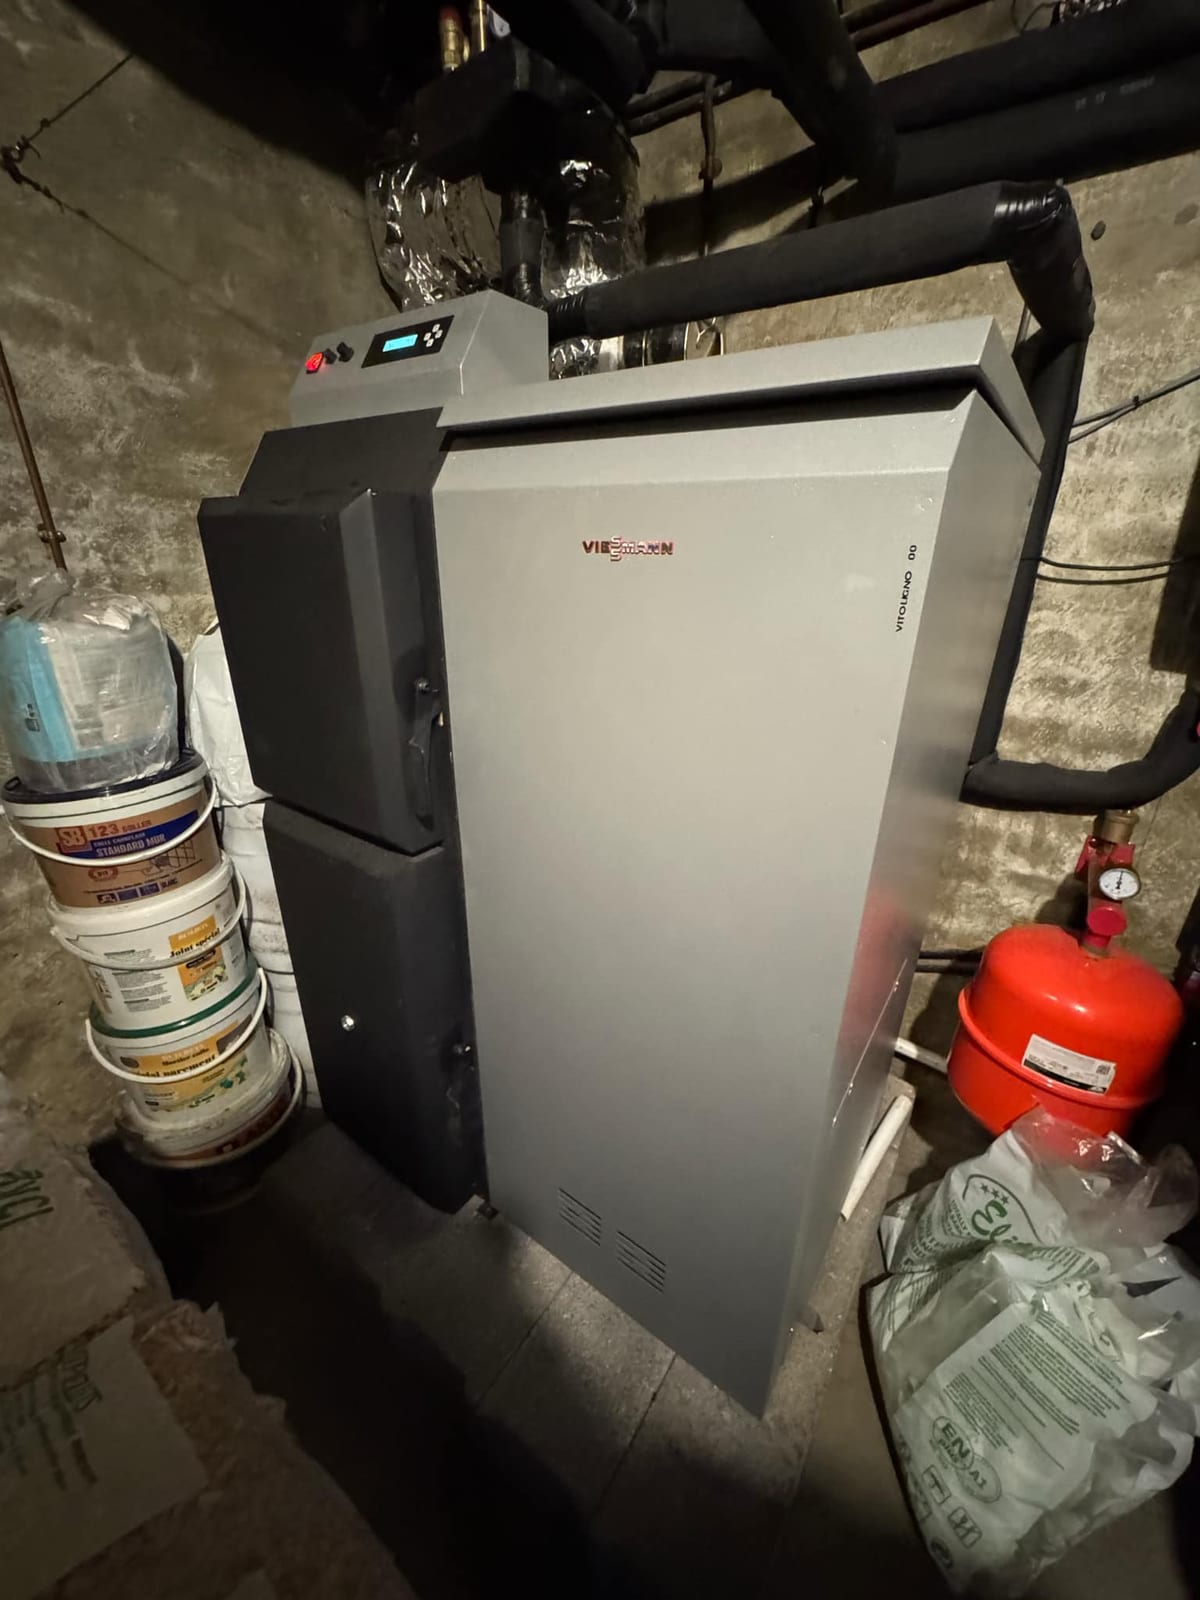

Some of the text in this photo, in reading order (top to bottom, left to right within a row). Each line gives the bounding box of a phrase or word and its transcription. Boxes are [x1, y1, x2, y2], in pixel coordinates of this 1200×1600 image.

[582, 536, 674, 562] VIESSMANN
[895, 570, 913, 632] VITOLIGNO
[88, 823, 119, 839] 123
[96, 833, 166, 857] STANDARD MUR
[169, 945, 193, 958] Joint
[942, 1423, 970, 1458] EN
[968, 1469, 988, 1490] A1
